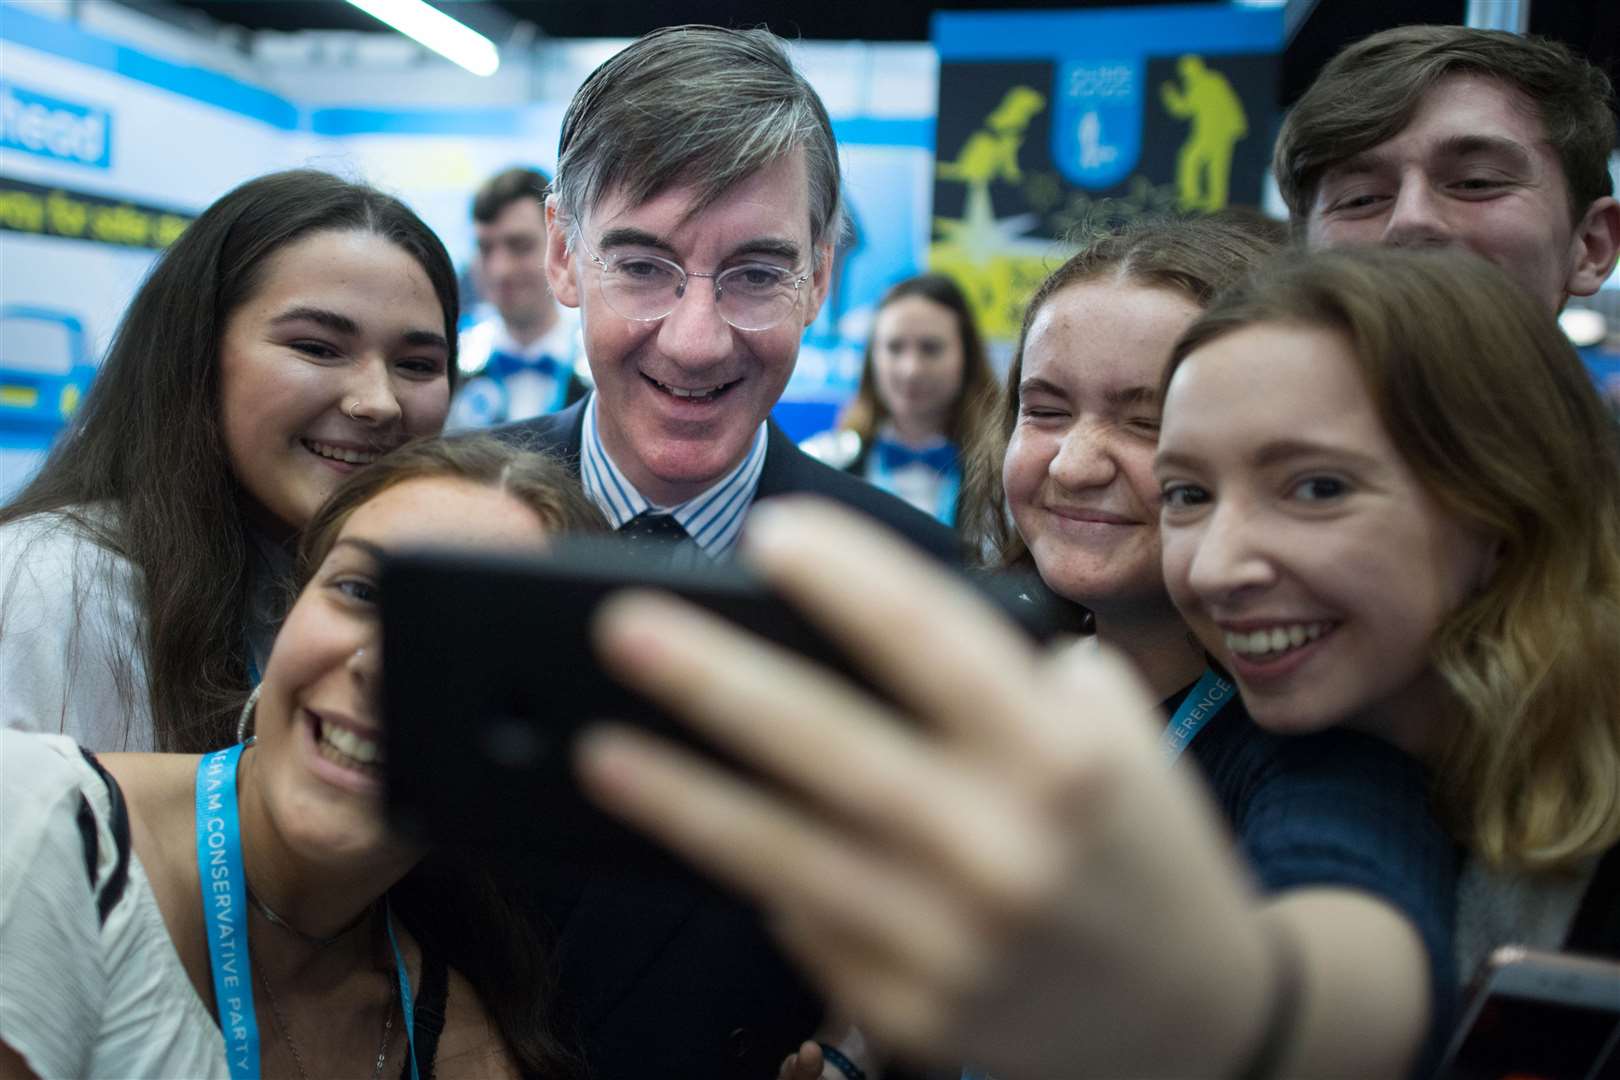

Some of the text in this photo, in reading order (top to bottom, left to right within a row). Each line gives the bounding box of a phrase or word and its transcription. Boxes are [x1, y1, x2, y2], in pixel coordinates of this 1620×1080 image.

[1166, 678, 1231, 750] FERENCE
[207, 817, 240, 988] CONSERVATIVE
[228, 997, 249, 1070] PARTY
